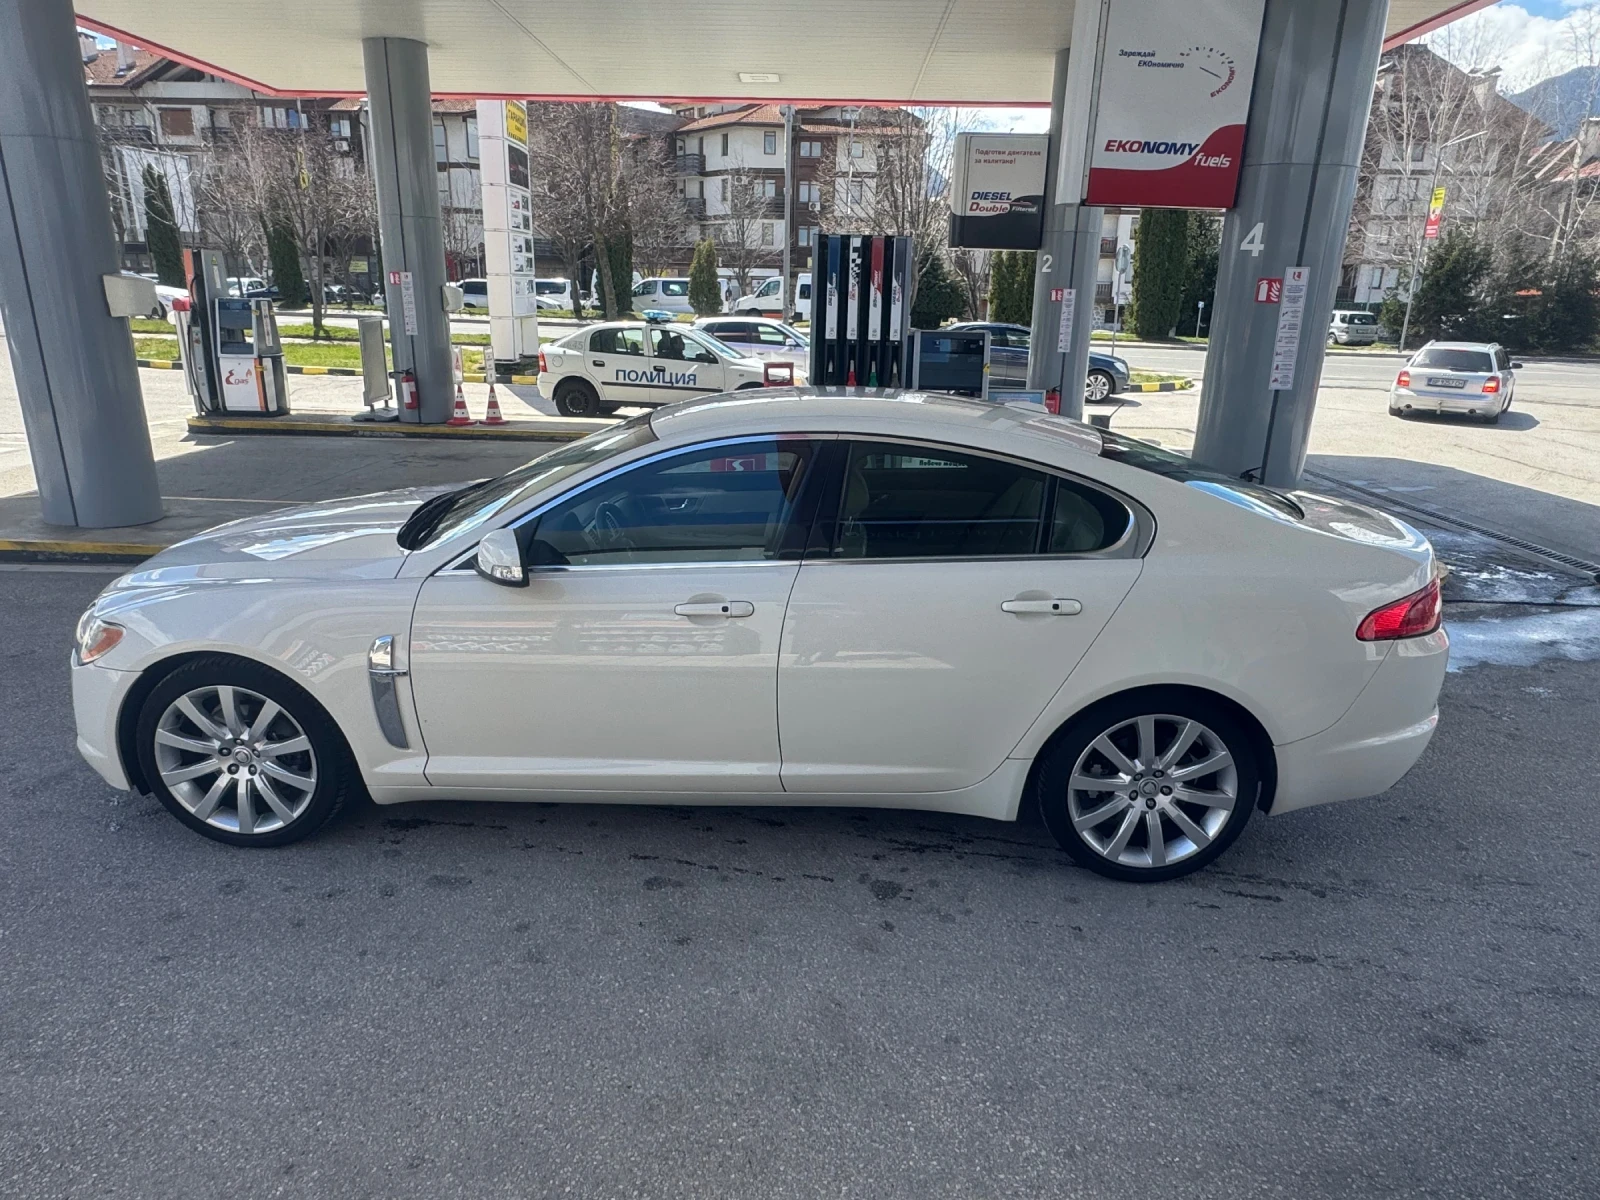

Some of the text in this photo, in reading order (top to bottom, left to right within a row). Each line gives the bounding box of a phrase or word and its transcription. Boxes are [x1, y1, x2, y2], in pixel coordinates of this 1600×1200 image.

[1119, 49, 1156, 58] Зареждай
[1138, 60, 1184, 69] ЕКОномично
[1210, 66, 1236, 98] EKONOMY
[975, 148, 1006, 156] Подготви
[1104, 139, 1201, 156] EKONOMY
[1194, 152, 1232, 168] fuels
[971, 191, 1013, 201] DIESEL
[969, 202, 1009, 213] Double
[1240, 222, 1265, 257] 4
[1041, 254, 1053, 273] 2
[615, 369, 697, 386] ПОЛИЦИЯ
